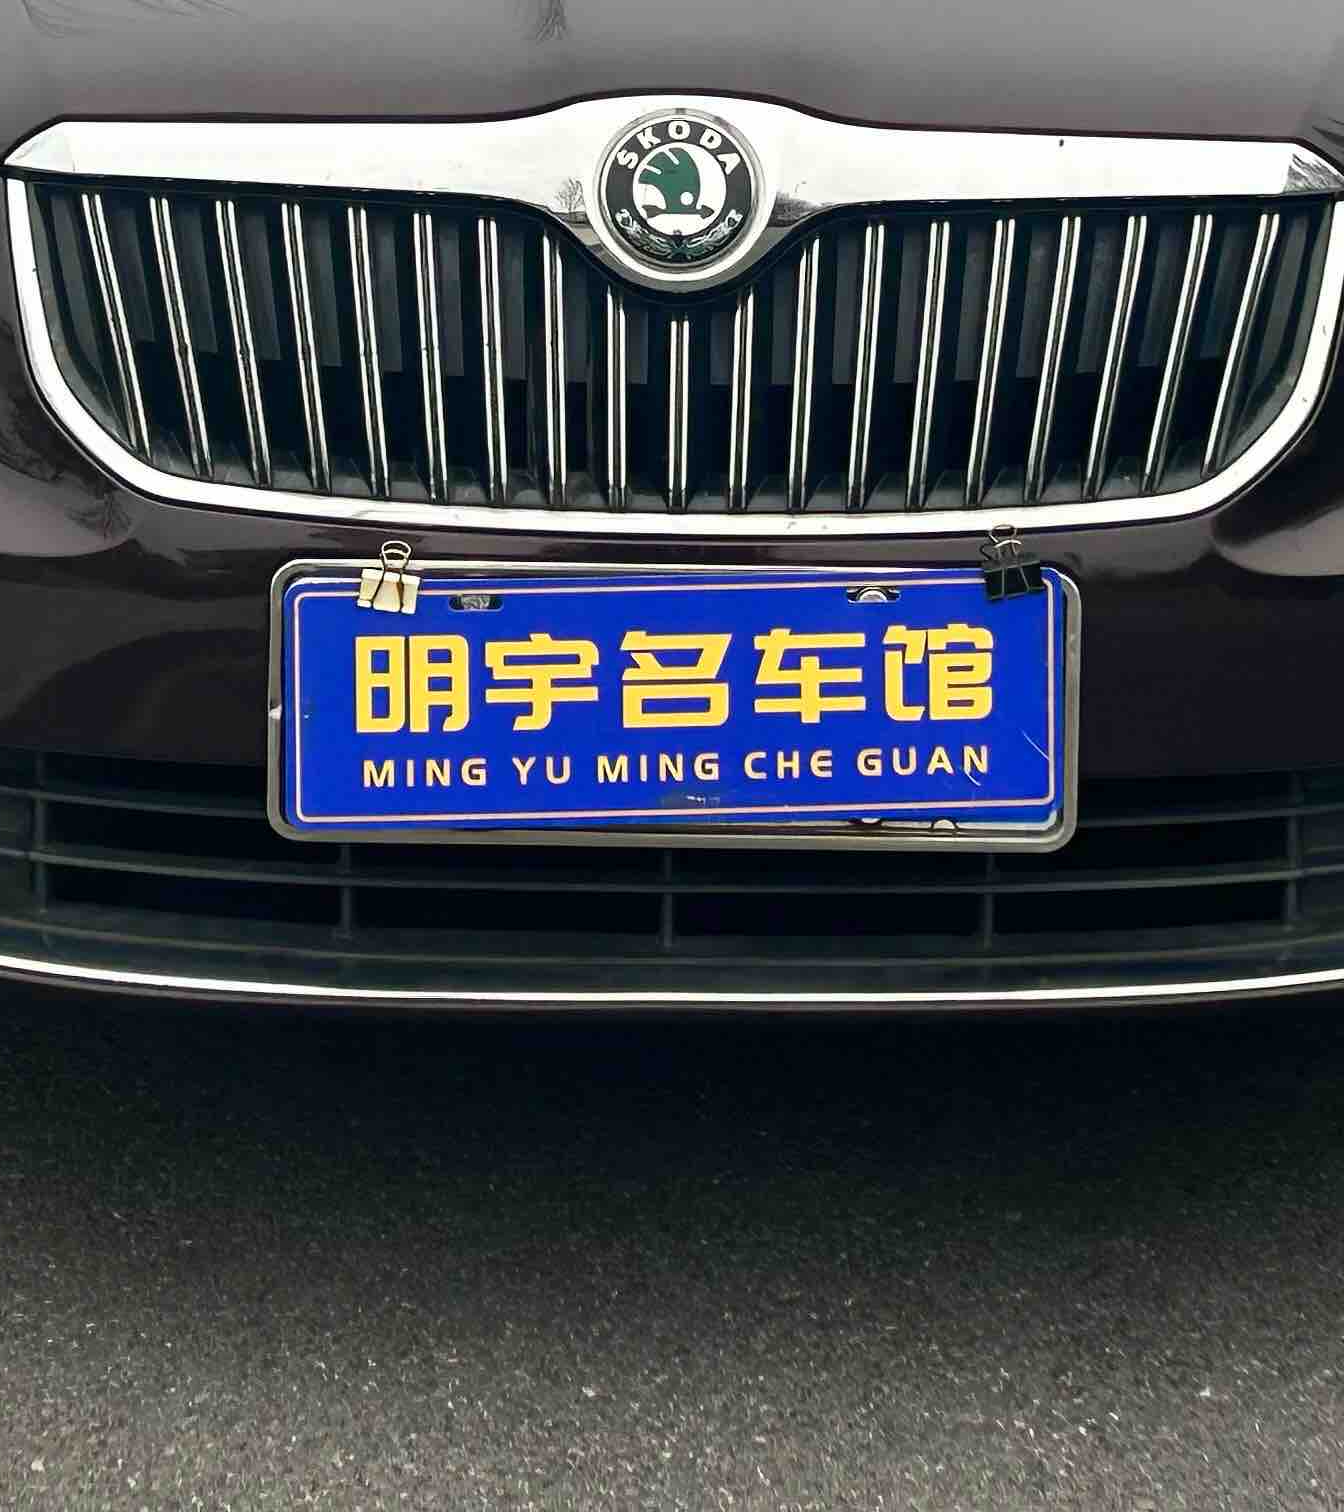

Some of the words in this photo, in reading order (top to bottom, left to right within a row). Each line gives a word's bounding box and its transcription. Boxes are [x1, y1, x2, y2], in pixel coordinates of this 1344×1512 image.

[616, 119, 742, 175] SKODA
[355, 623, 994, 733] 明宇名车馆
[362, 757, 488, 788] MING
[511, 755, 572, 786] YU
[596, 752, 720, 784] MING
[743, 749, 834, 780] CHE
[856, 744, 989, 778] GUAN
